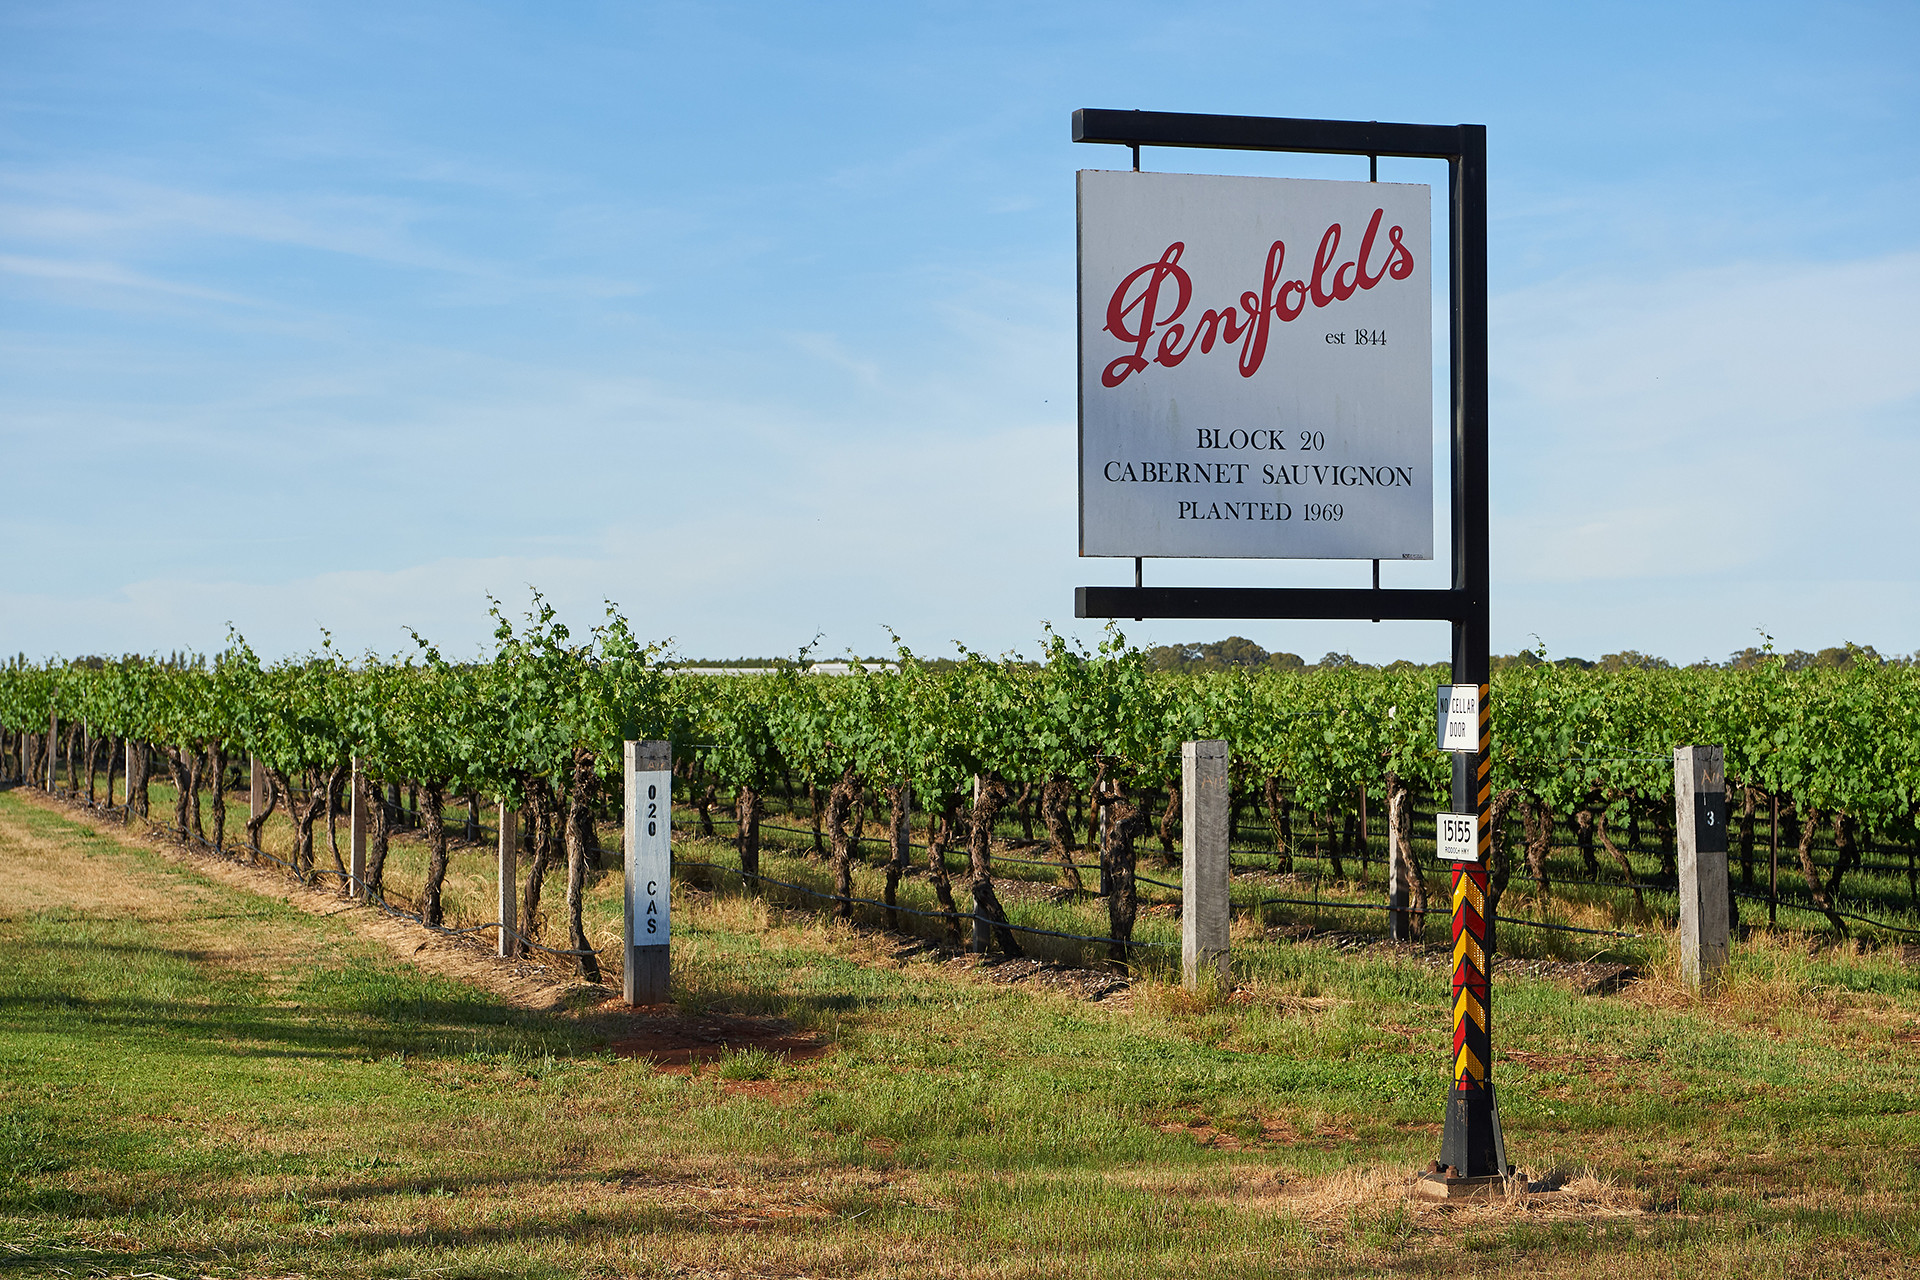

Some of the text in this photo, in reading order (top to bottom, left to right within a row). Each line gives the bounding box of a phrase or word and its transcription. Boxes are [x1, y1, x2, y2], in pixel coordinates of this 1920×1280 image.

[1101, 208, 1414, 388] Penfolds
[1325, 328, 1387, 346] est 1844
[1196, 428, 1325, 452] BLOCK 20
[1103, 460, 1414, 487] CABERNET SAUVIGNON
[1177, 501, 1344, 522] PLANTED 1969
[1440, 698, 1475, 713] NO CELLAR
[1450, 722, 1466, 737] DOOR
[1706, 811, 1715, 826] 3
[1443, 819, 1471, 843] 15155
[646, 784, 658, 935] 020 CAS
